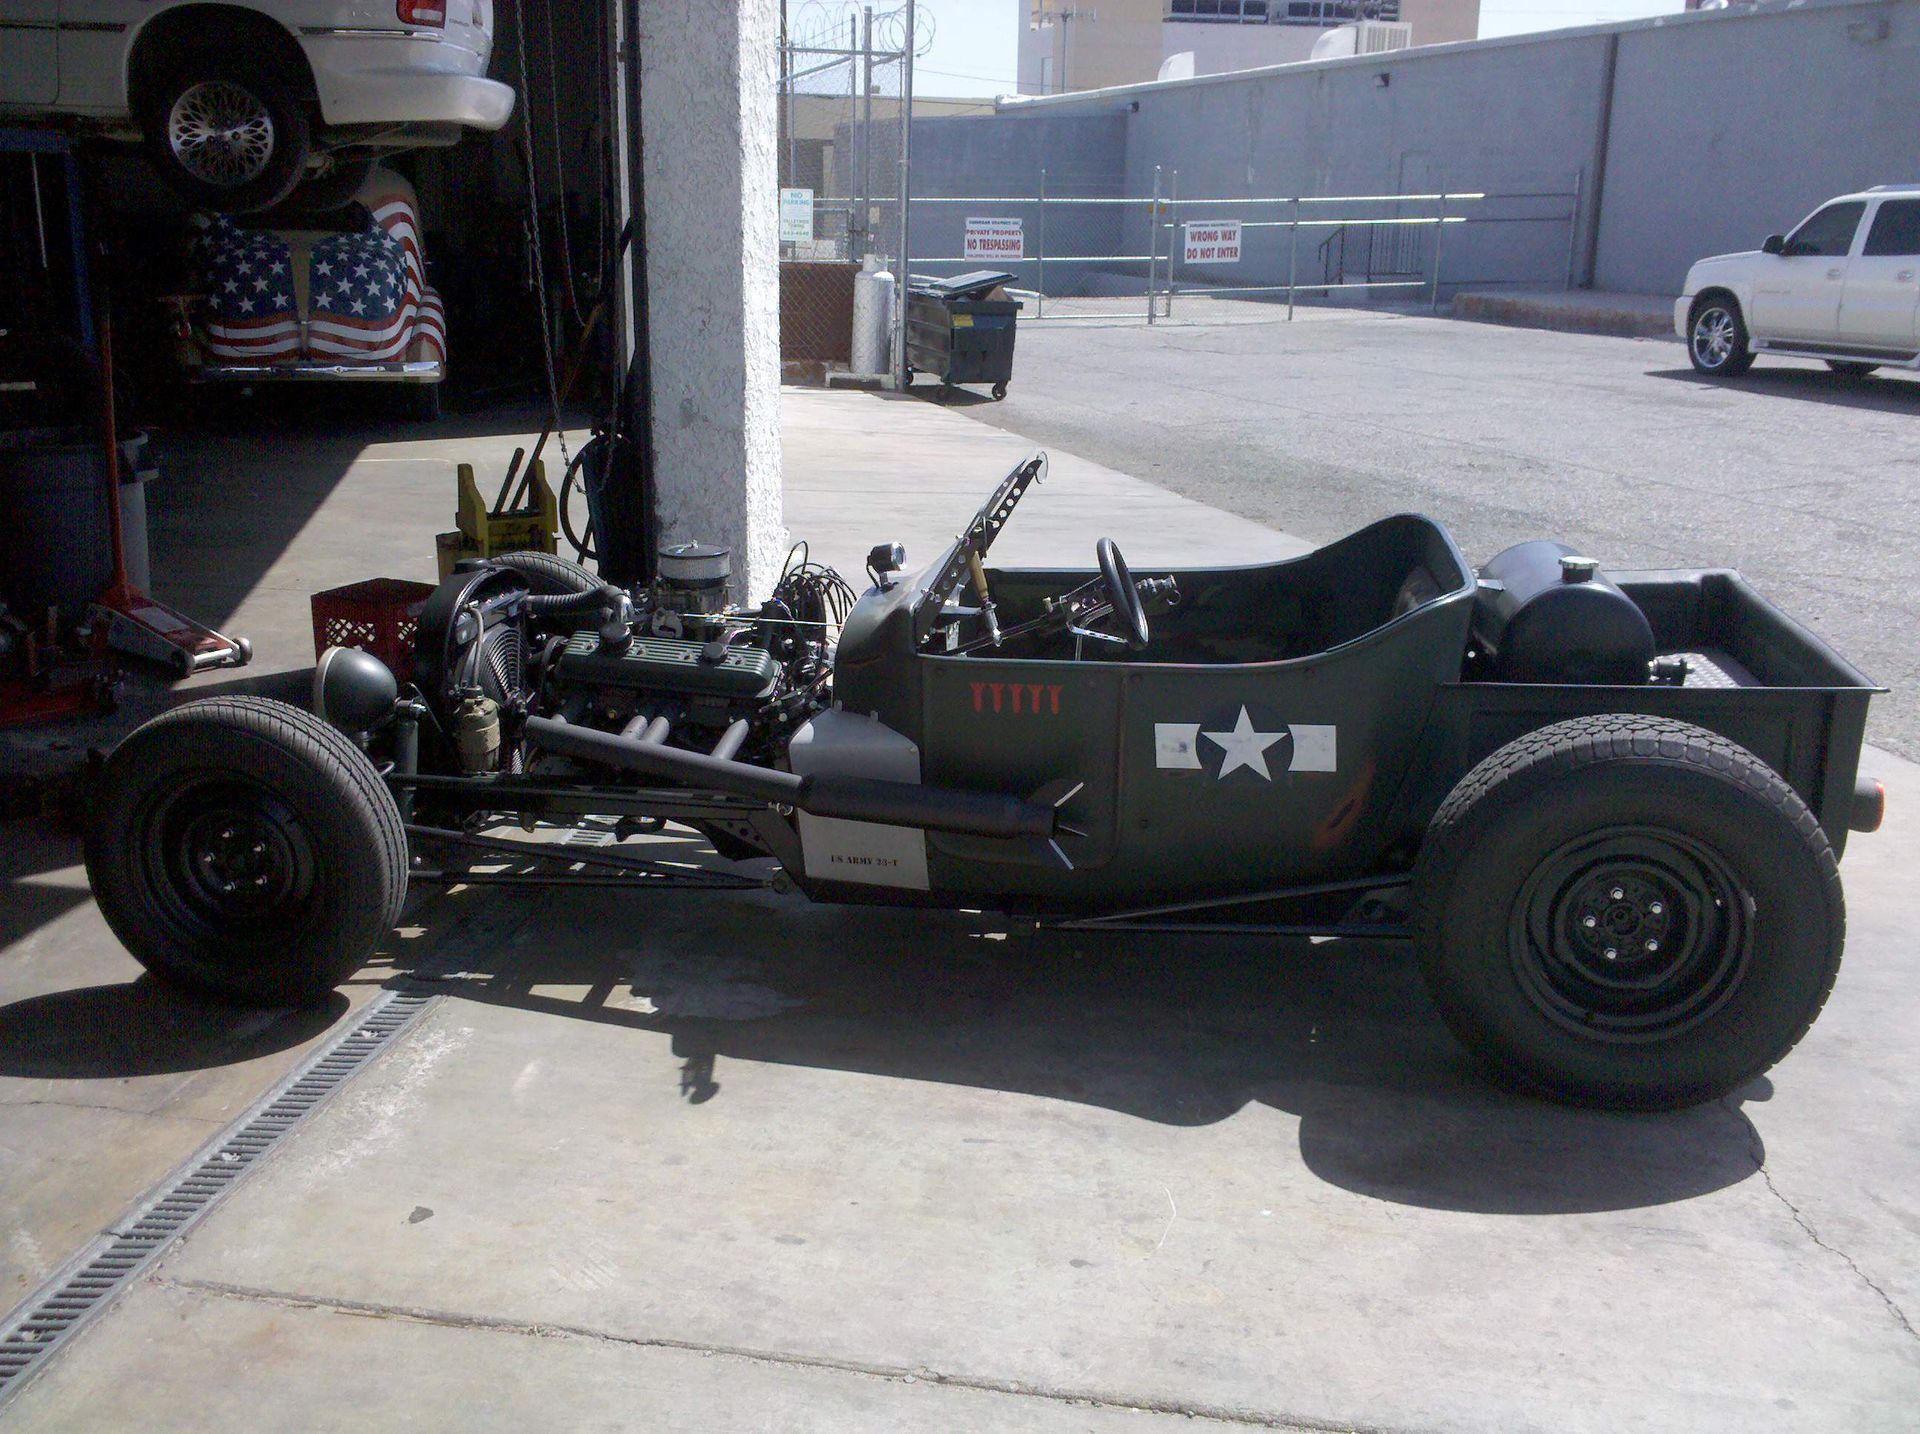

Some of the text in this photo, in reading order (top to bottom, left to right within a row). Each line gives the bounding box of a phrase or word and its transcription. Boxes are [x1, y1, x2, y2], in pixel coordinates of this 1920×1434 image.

[790, 191, 803, 199] NO
[1190, 229, 1237, 242] WRONG WAY
[967, 238, 1021, 250] NO TRESPASSING
[1186, 246, 1239, 259] DO NOT ENTER
[847, 855, 872, 865] ARMY
